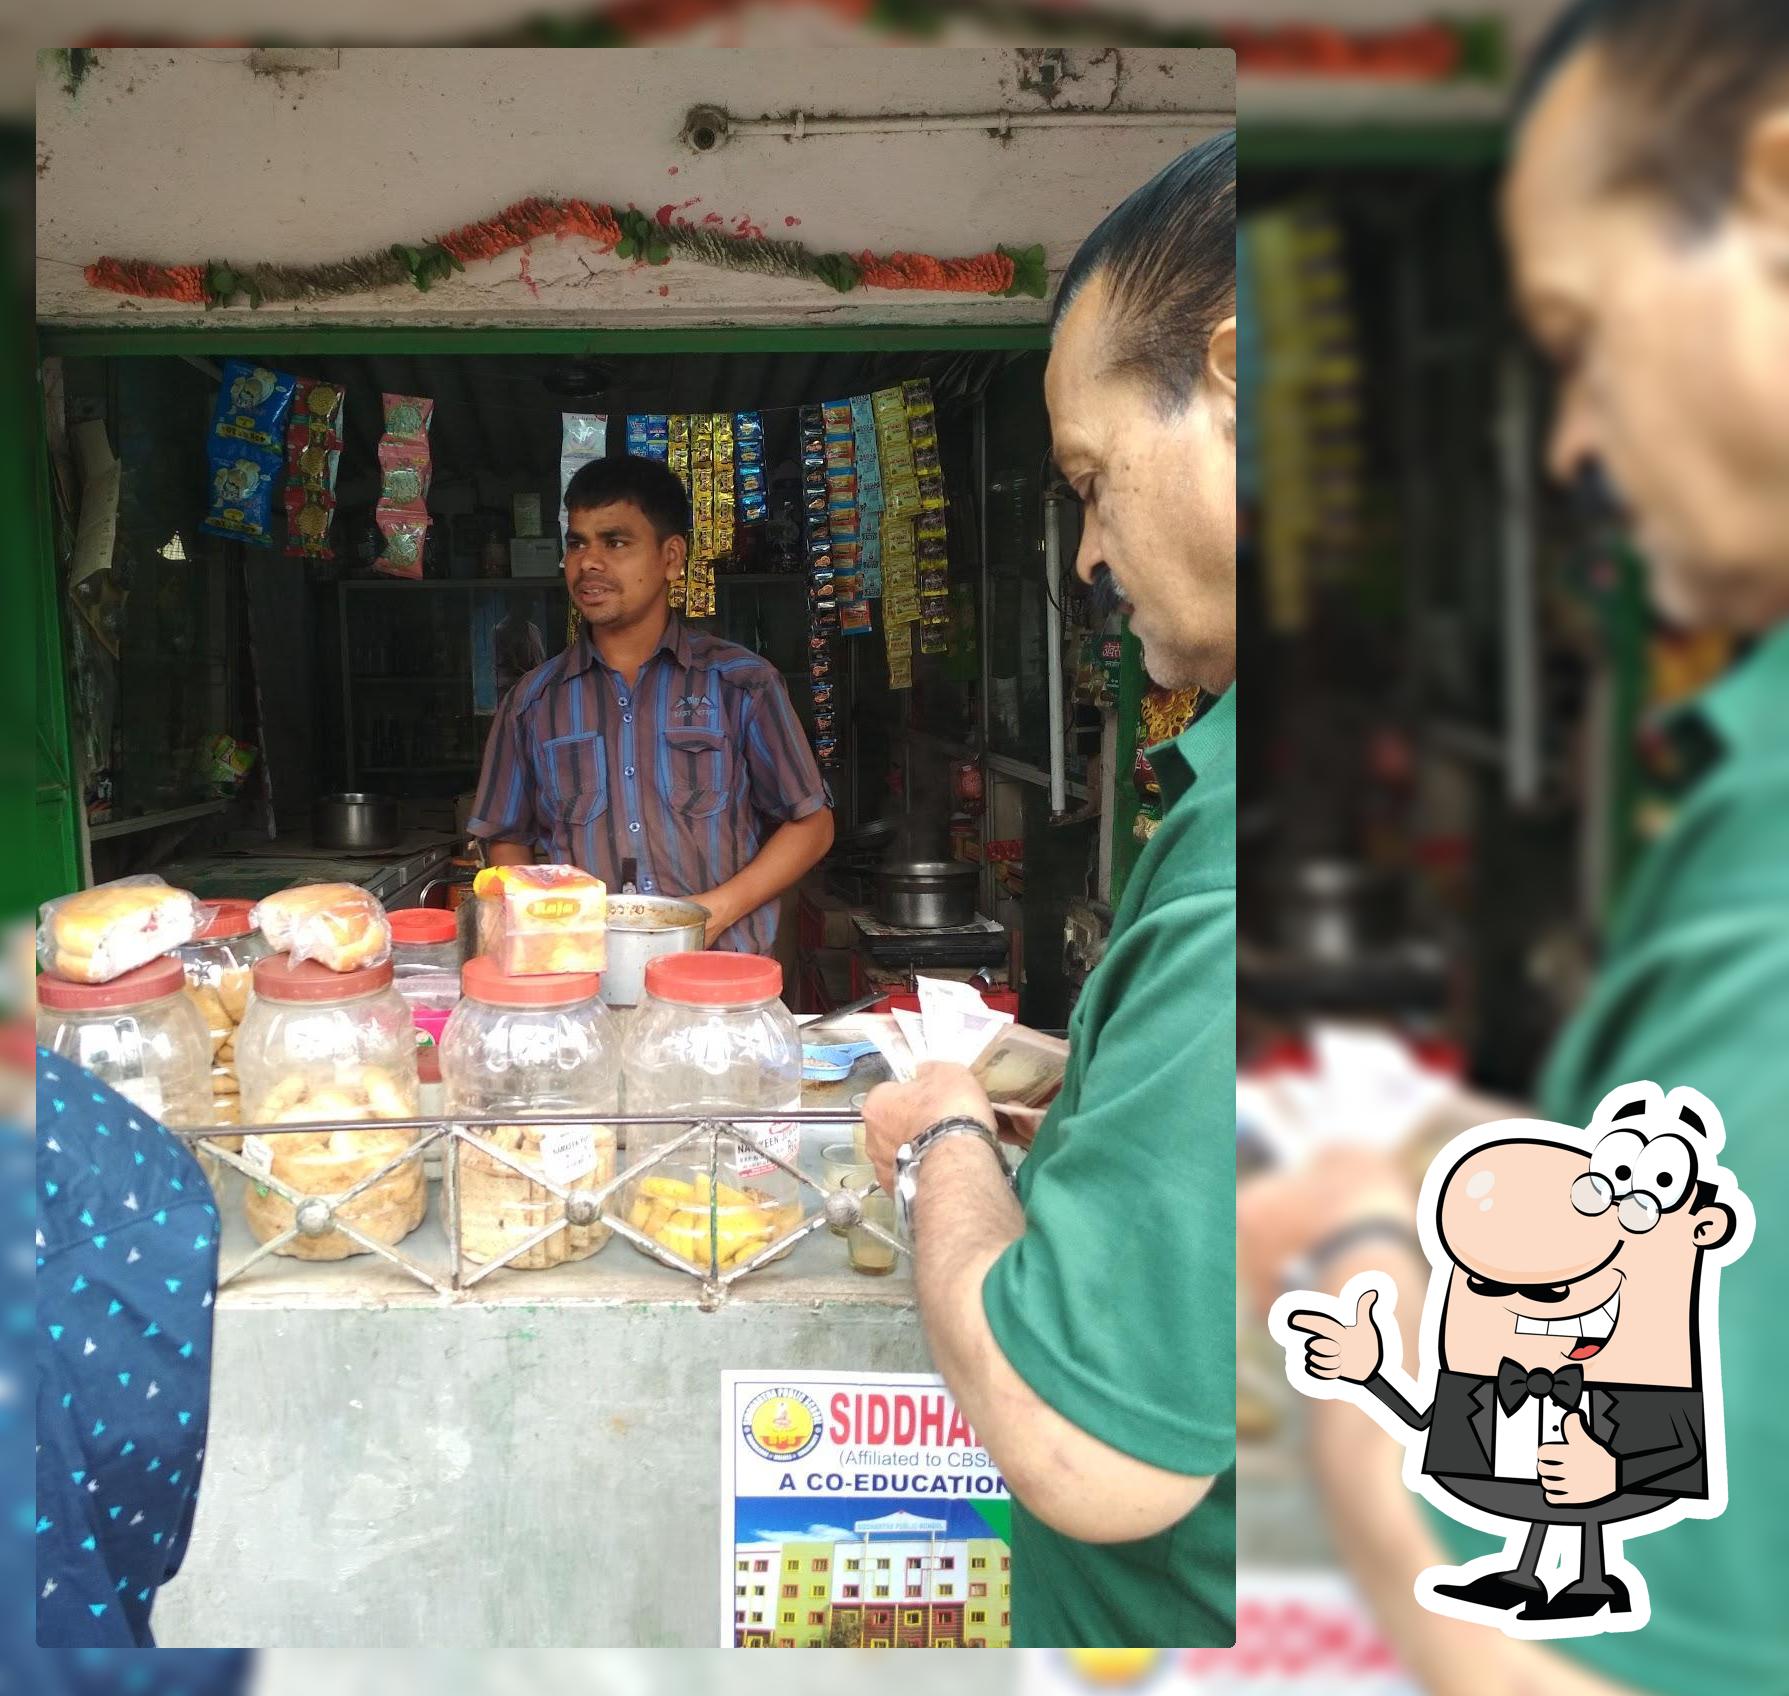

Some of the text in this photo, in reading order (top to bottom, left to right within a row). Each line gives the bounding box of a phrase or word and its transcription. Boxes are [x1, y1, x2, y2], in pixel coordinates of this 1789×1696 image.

[829, 1392, 983, 1447] SIDDHA
[839, 1449, 919, 1468] (Affiliated
[926, 1451, 941, 1467] to
[779, 1473, 796, 1490] A
